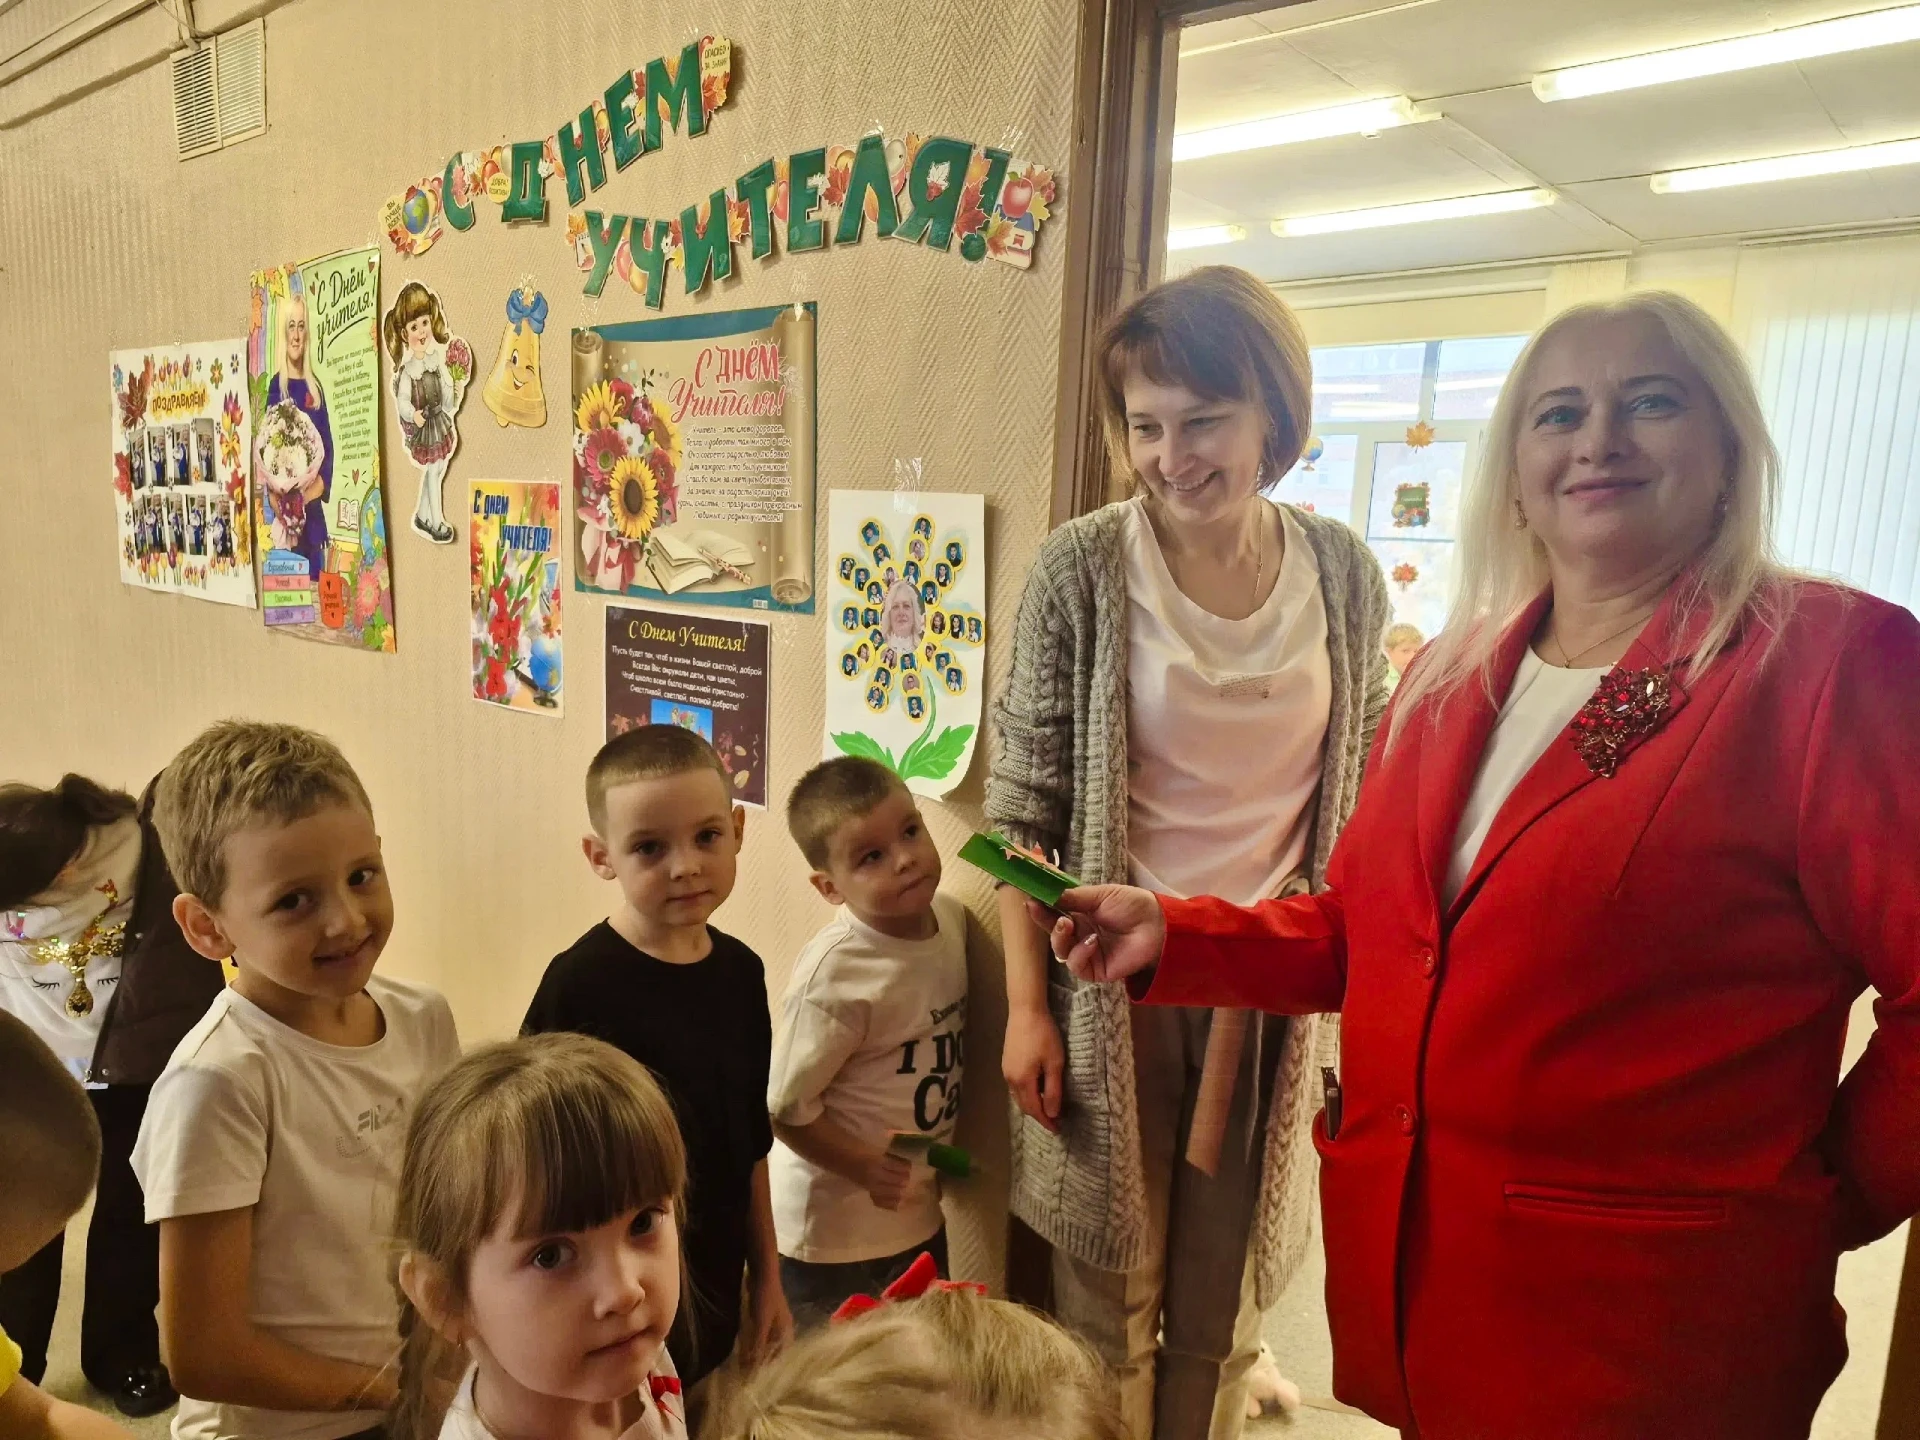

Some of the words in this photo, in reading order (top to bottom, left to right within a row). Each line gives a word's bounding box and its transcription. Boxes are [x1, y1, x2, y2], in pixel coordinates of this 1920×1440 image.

[441, 151, 476, 232] С
[501, 41, 707, 224] ДНЕМ
[583, 132, 1012, 310] УЧИТЕЛЯ!
[317, 280, 327, 315] С
[329, 267, 366, 308] Днём
[316, 275, 376, 365] учителя!
[694, 348, 713, 388] С
[152, 388, 206, 413] ПОЗДРАВЛЯЕМ!
[668, 377, 786, 423] Учителя!
[473, 489, 481, 514] С
[483, 494, 510, 520] днем
[500, 524, 552, 552] УЧИТЕЛЯ!
[629, 620, 639, 639] С
[640, 621, 676, 643] Днем
[678, 626, 749, 652] Учителя!
[739, 666, 763, 677] доброй
[896, 1040, 919, 1074] I
